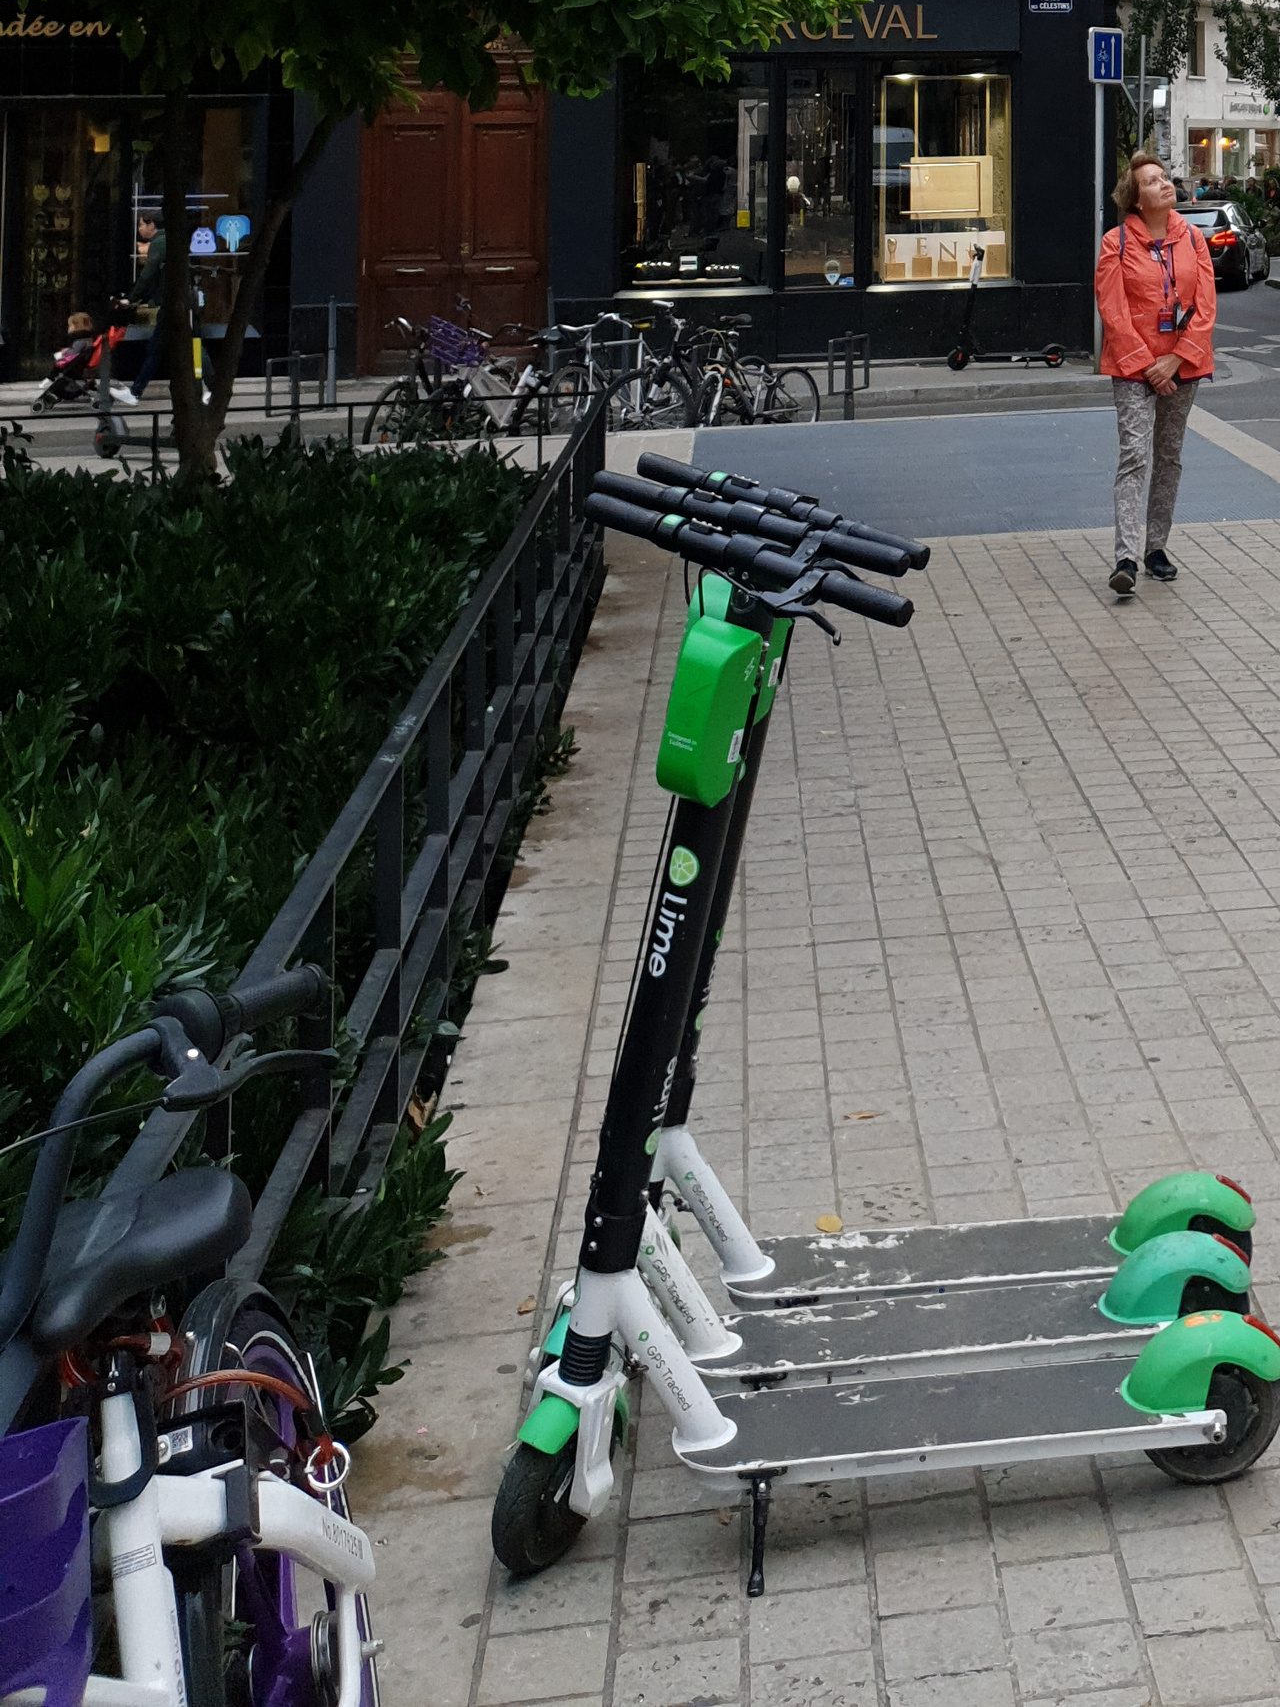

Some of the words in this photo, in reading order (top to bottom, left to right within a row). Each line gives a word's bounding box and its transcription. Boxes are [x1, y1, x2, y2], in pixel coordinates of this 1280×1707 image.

[69, 20, 112, 37] en
[648, 891, 688, 978] Lime
[652, 1259, 671, 1283] GPS
[667, 1279, 697, 1326] Tracked
[647, 1345, 666, 1370] GPS
[660, 1367, 693, 1413] Tracked
